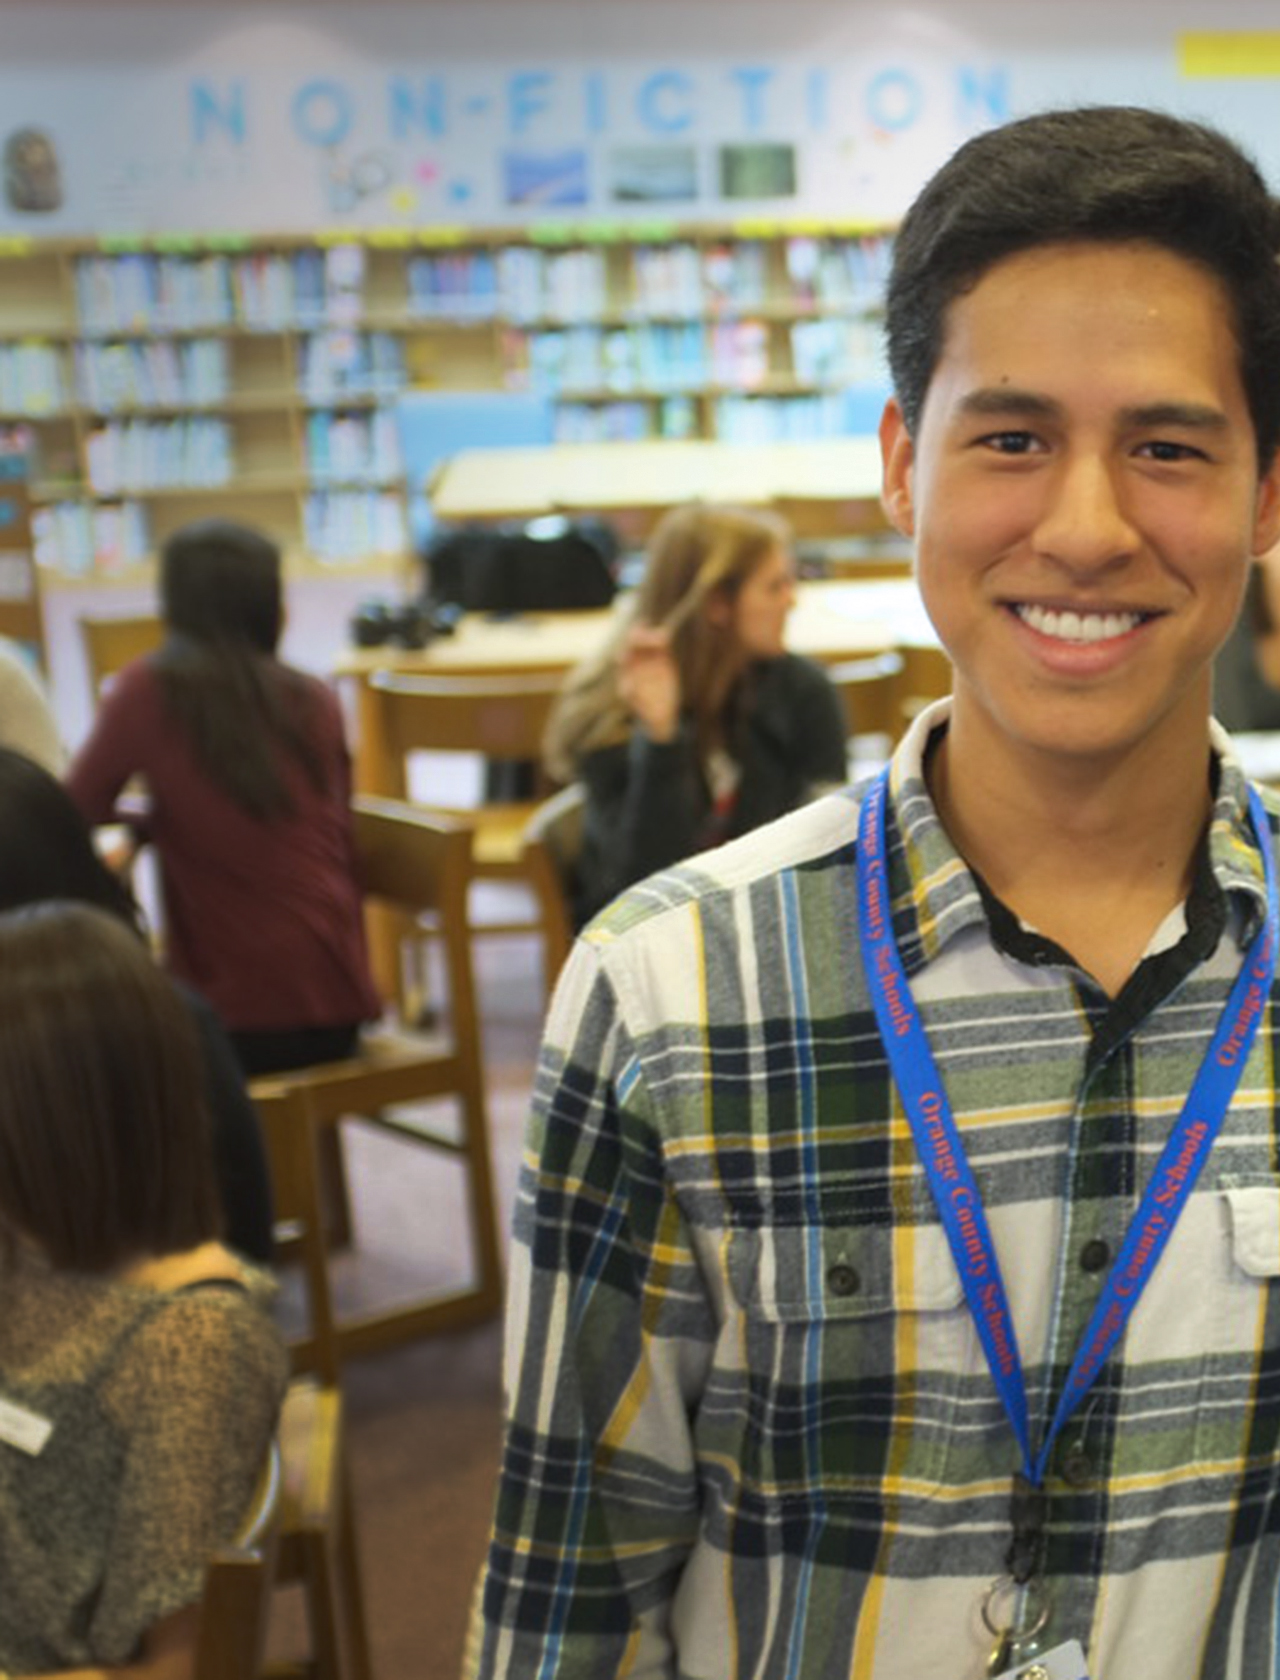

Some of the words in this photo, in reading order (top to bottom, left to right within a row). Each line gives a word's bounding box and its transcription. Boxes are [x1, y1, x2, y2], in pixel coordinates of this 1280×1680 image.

[188, 67, 1009, 147] NON-FICTION
[866, 860, 884, 940] County
[875, 946, 914, 1037] Schools
[1216, 984, 1261, 1066] Orange
[918, 1091, 959, 1181] Orange
[951, 1186, 989, 1276] County
[979, 1283, 1017, 1375] Schools
[1114, 1209, 1168, 1296] County
[1152, 1119, 1208, 1208] Schools
